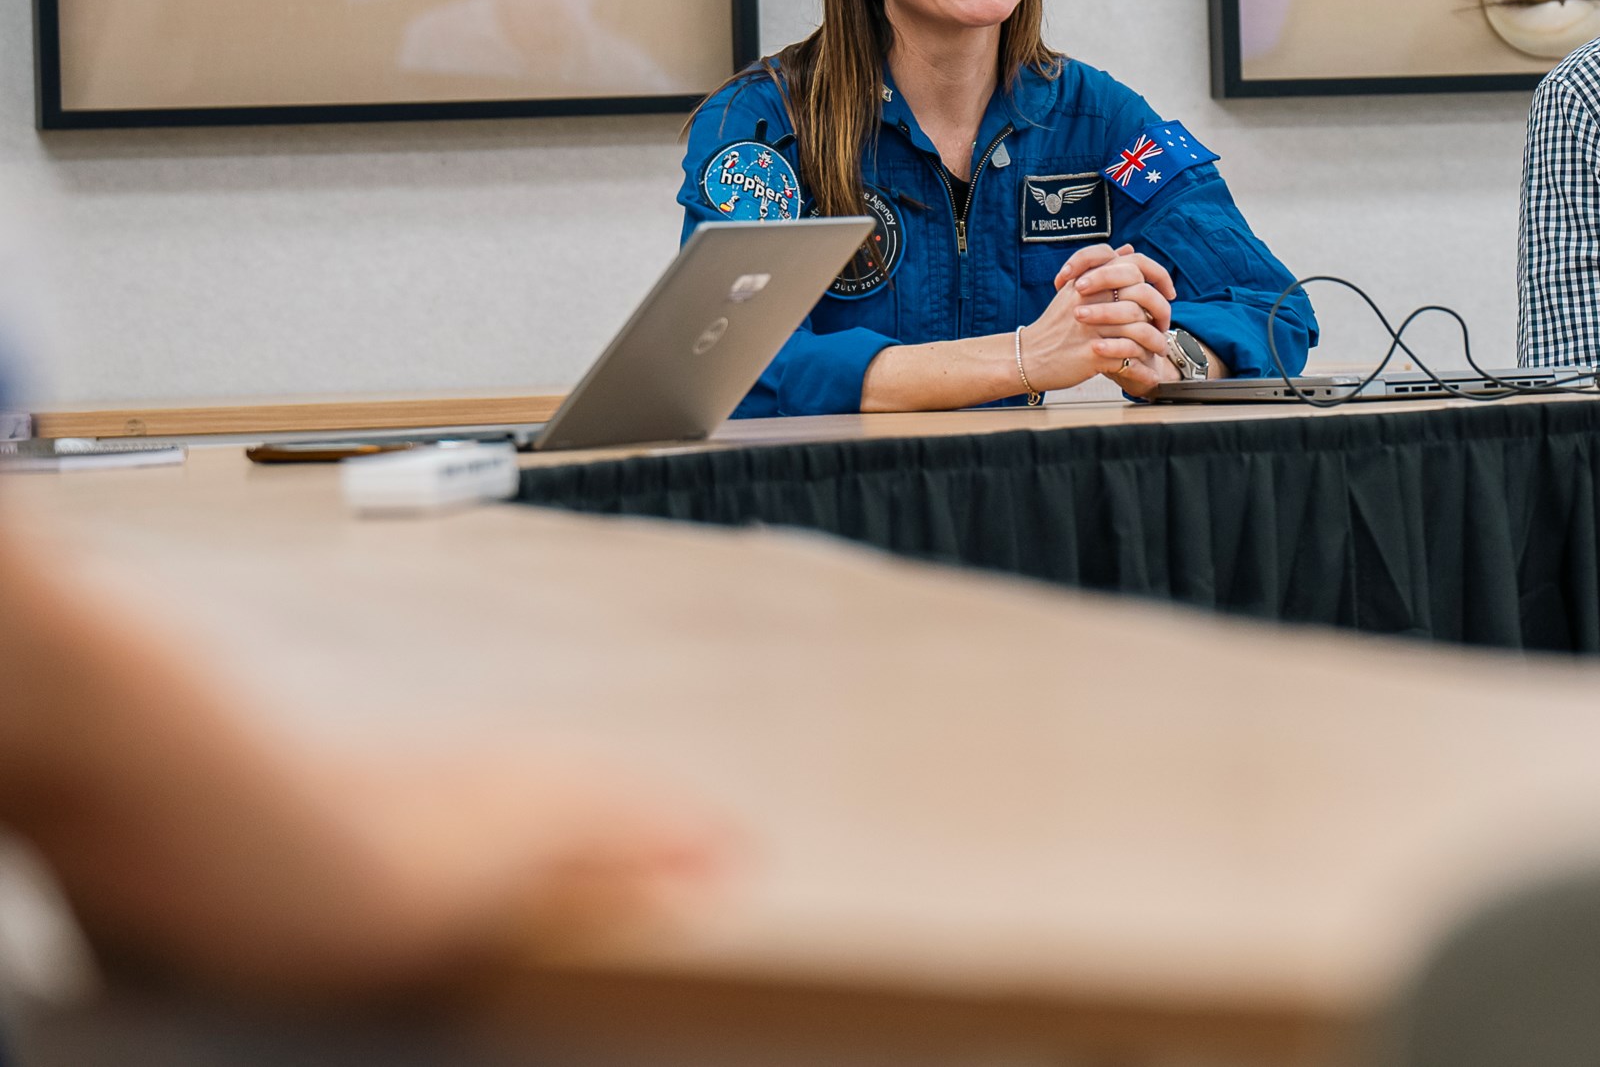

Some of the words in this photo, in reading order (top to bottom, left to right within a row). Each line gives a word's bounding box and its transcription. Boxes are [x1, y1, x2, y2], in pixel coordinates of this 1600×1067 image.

[720, 168, 789, 211] hoppers
[870, 194, 896, 225] Agency
[834, 282, 857, 292] JULY
